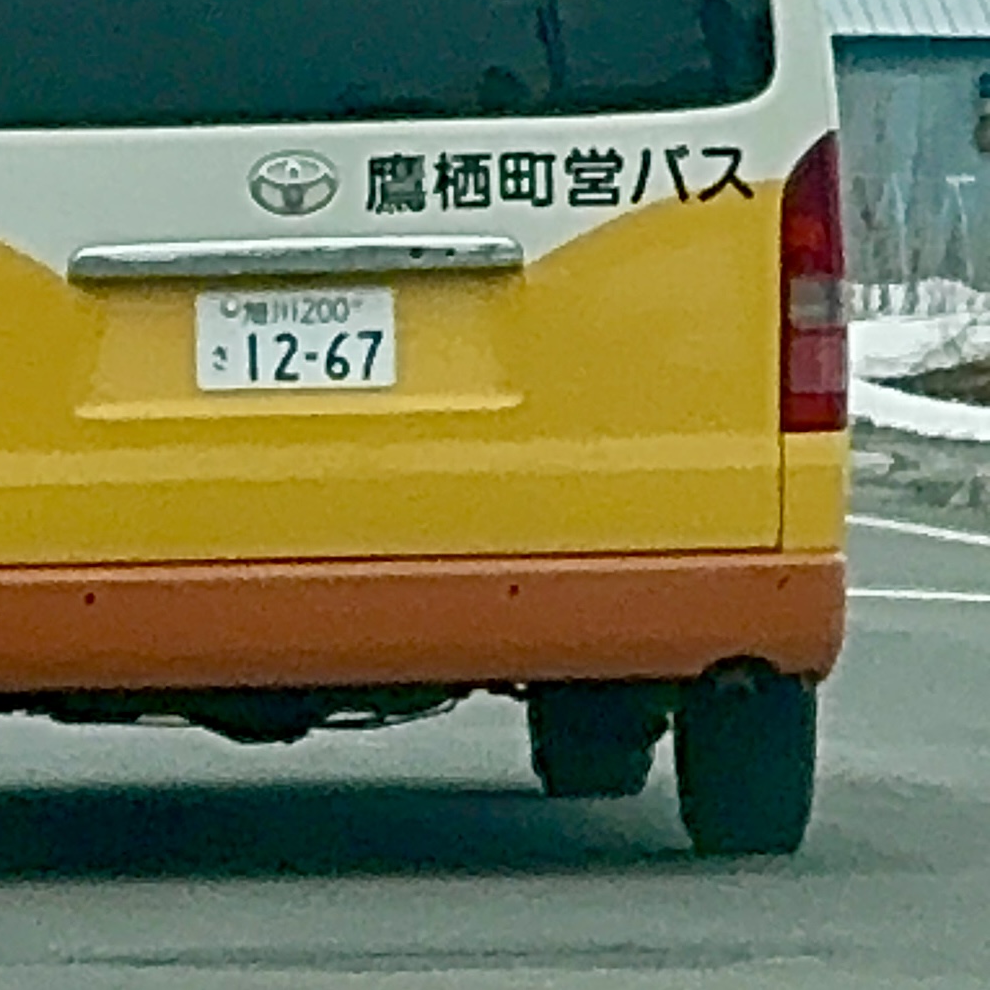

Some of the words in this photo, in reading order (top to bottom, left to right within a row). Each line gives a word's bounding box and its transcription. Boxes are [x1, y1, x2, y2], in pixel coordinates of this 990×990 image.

[365, 145, 754, 214] 鷹栖町営バス
[247, 331, 383, 382] 12-67
